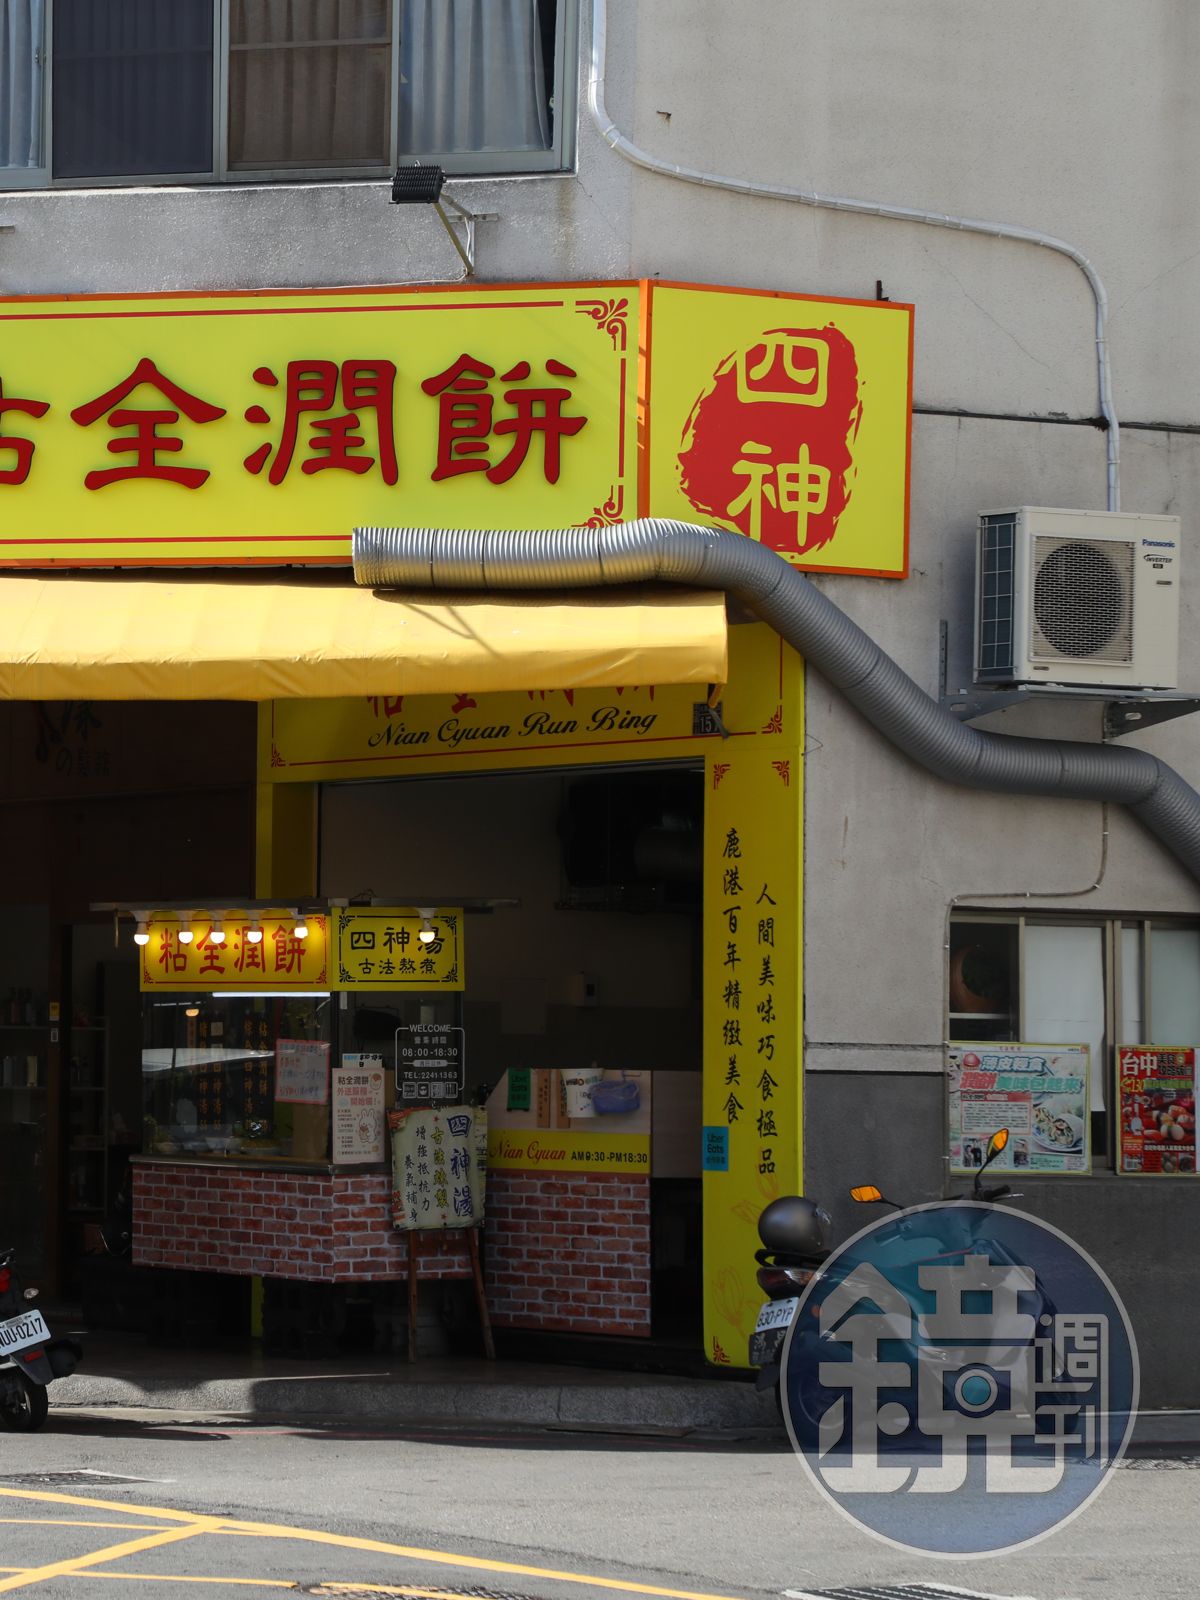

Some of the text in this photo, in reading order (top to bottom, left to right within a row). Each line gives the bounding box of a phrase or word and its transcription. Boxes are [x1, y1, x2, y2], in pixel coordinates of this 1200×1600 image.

[726, 334, 831, 547] 四神
[1142, 538, 1176, 548] Panasonic
[367, 723, 430, 748] Nian
[517, 711, 578, 737] Run
[586, 706, 658, 735] Bing
[158, 924, 307, 975] 粘全潤餅
[350, 925, 445, 955] 四神湯
[409, 1024, 452, 1033] WELCOME
[1122, 1052, 1158, 1076] 台中
